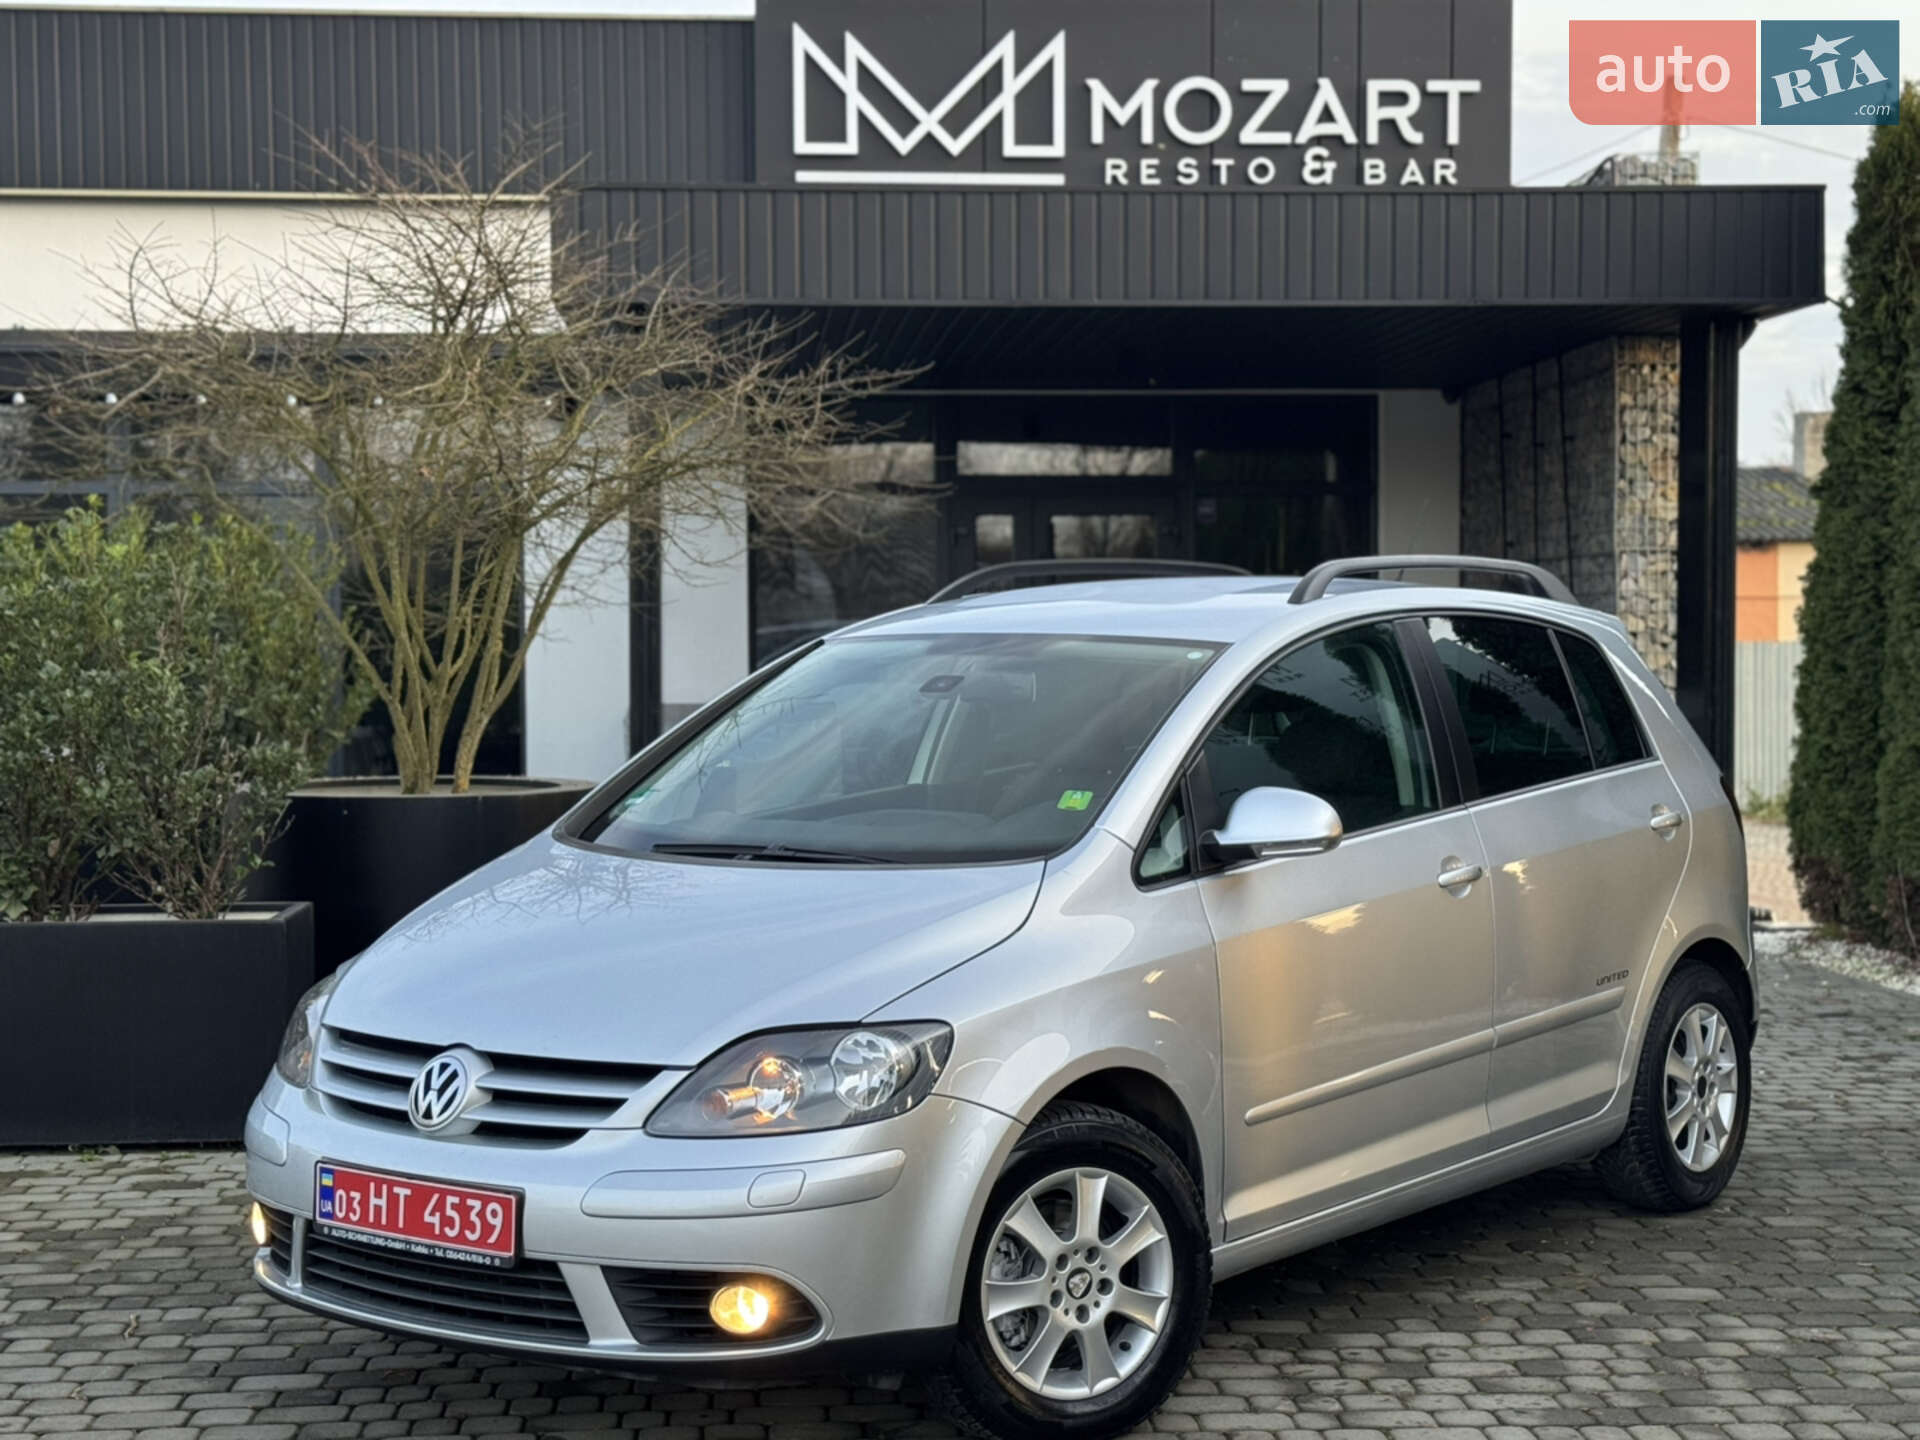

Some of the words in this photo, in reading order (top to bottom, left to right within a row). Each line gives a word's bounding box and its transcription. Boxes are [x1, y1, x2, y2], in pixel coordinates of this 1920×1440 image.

[1085, 76, 1482, 146] MOZART
[1105, 158, 1276, 185] RESTO
[1302, 147, 1338, 185] &
[1364, 159, 1458, 186] BAR
[1596, 969, 1629, 986] UNITED
[320, 1200, 333, 1214] UA
[423, 1193, 504, 1244] 4539
